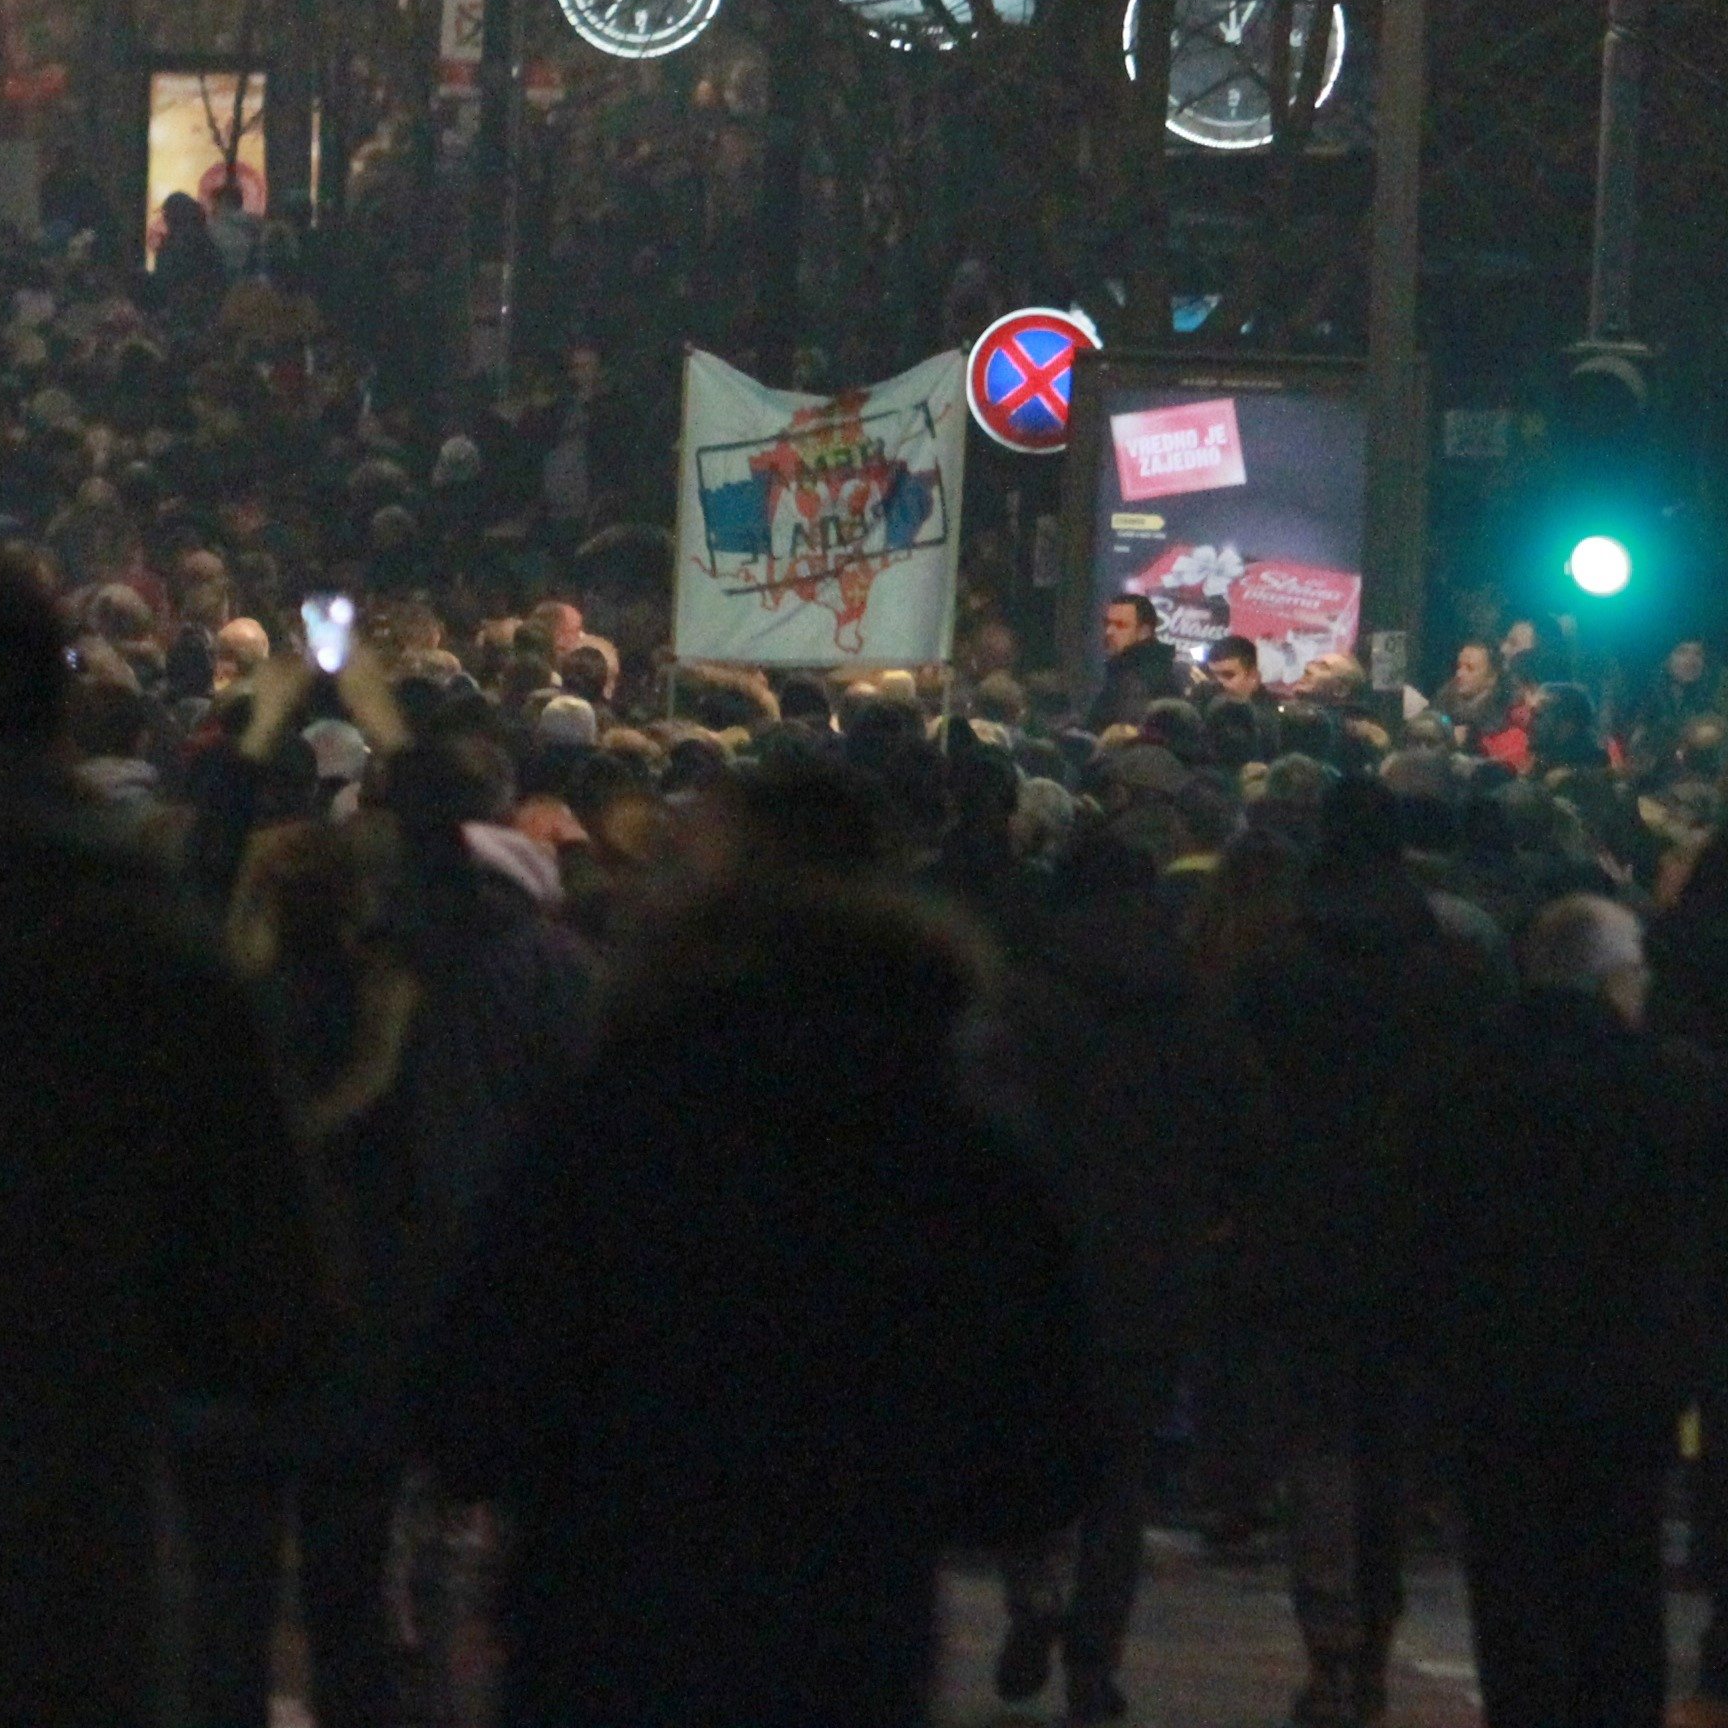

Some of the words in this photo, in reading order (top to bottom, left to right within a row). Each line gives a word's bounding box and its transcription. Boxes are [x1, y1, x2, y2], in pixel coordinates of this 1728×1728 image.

[1124, 428, 1198, 459] VREDNO
[1204, 423, 1228, 446] JE
[1139, 445, 1222, 477] ZAJEDNO
